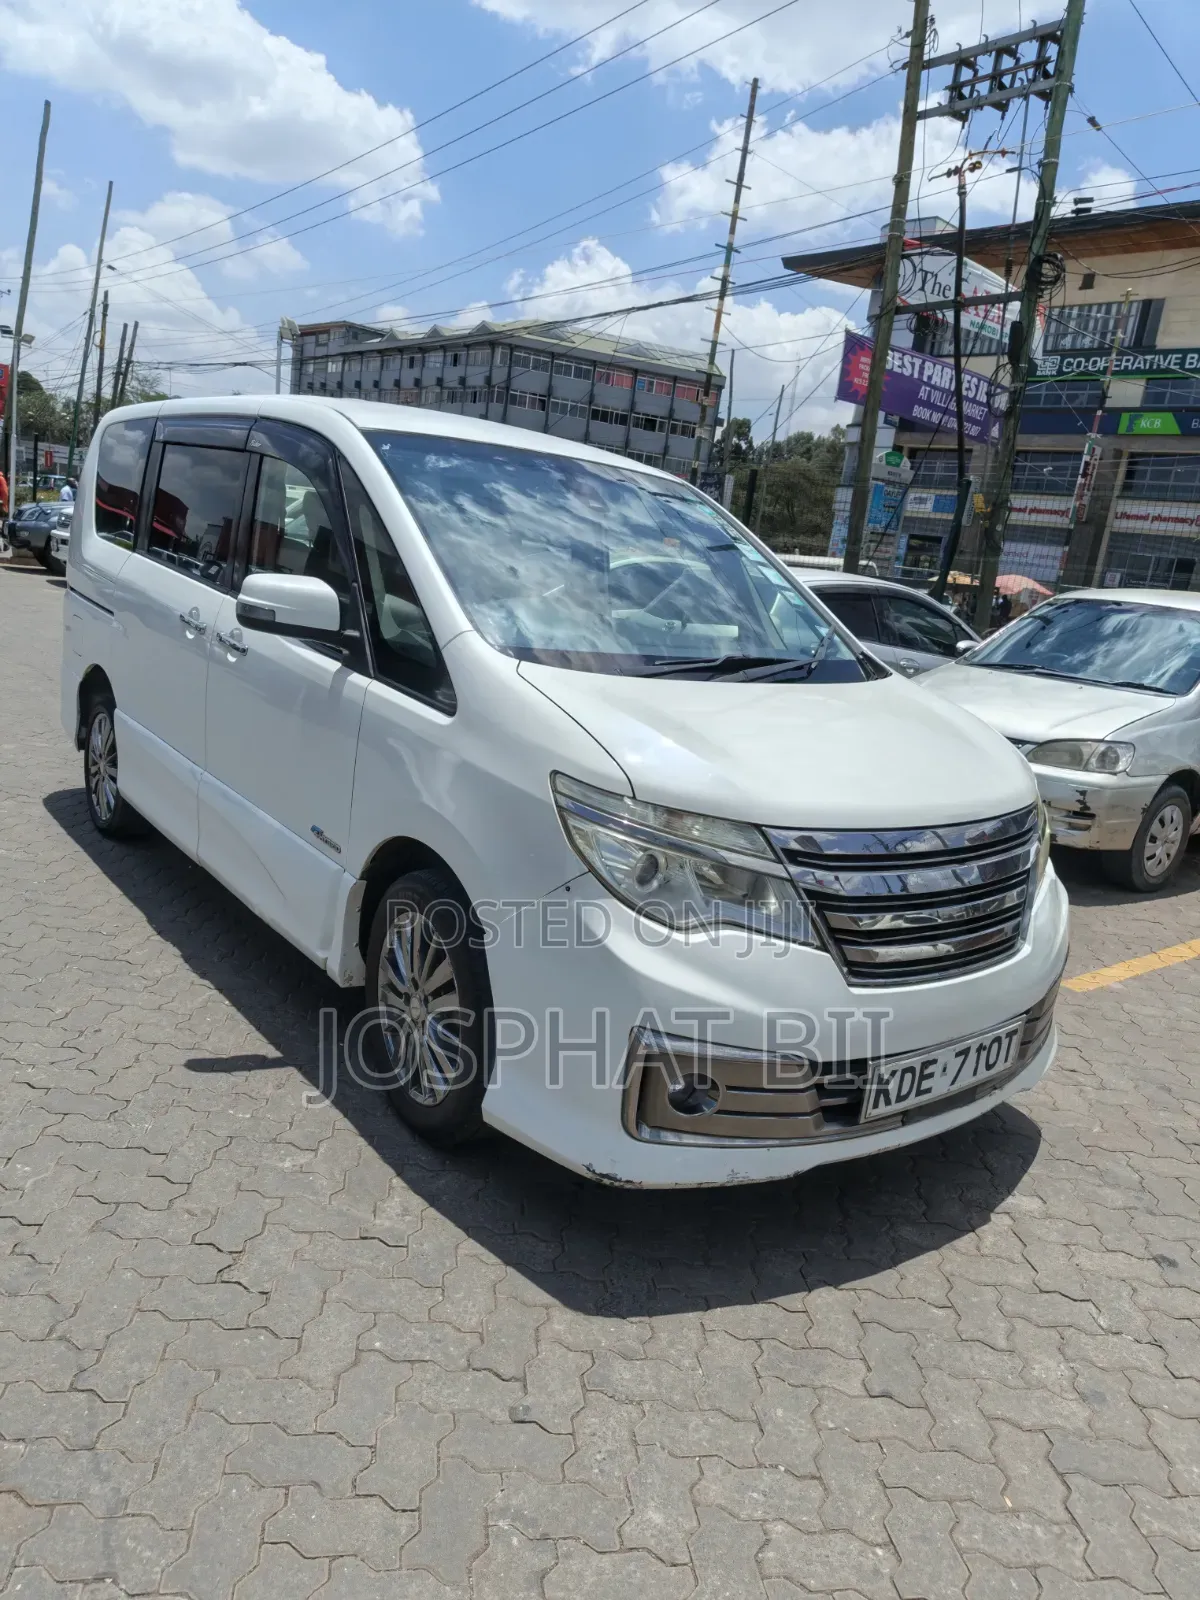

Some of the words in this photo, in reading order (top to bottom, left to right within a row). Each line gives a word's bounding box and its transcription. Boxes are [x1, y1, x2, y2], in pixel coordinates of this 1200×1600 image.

[918, 267, 952, 299] The
[886, 350, 922, 379] BEST
[1062, 354, 1183, 372] CO-OPERATIVE
[918, 385, 931, 401] AT
[930, 389, 958, 412] VILLAG
[963, 400, 988, 421] MARKET
[912, 404, 932, 421] BOOK
[1140, 418, 1161, 429] KCB
[1191, 418, 1200, 429] B
[1150, 513, 1195, 526] pharmacy
[872, 1058, 938, 1110] KDE
[950, 1028, 1018, 1087] 710T
